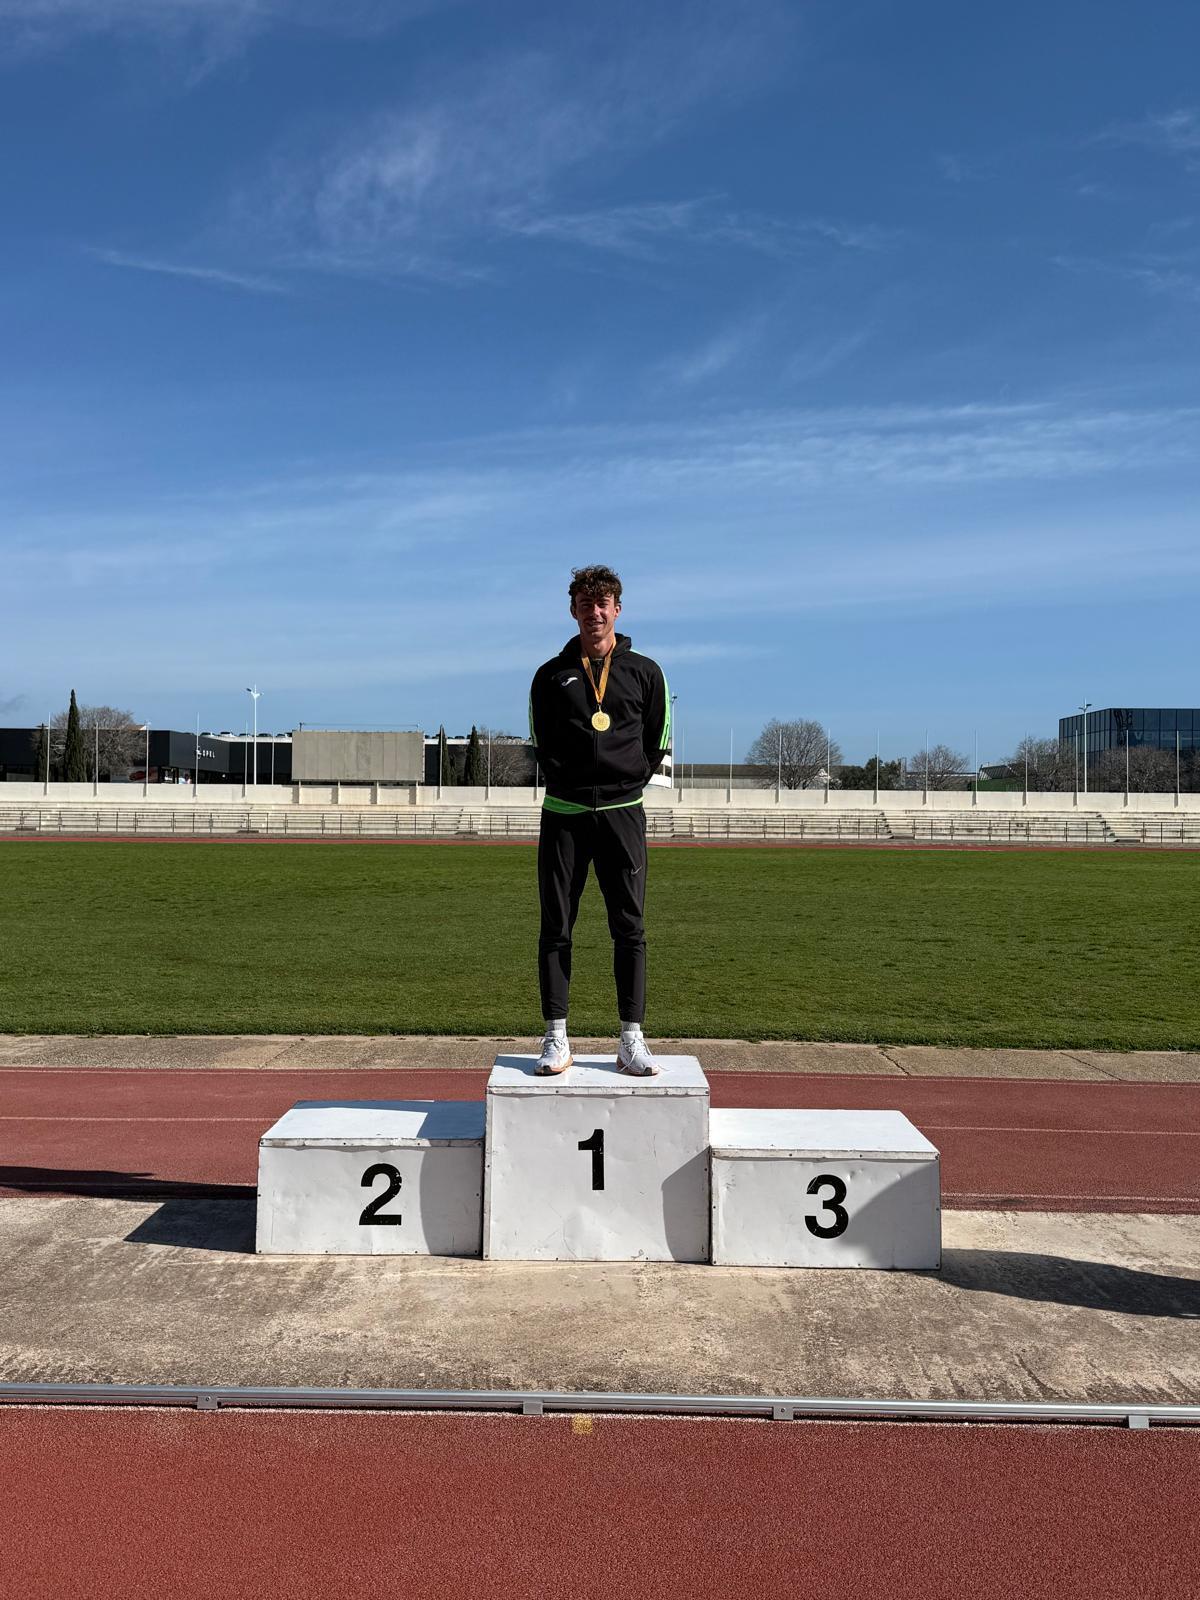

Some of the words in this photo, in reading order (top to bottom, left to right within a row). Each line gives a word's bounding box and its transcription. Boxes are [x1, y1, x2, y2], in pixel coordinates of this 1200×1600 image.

[202, 749, 216, 759] OPEL
[578, 1128, 605, 1191] 1
[358, 1163, 403, 1226] 2
[804, 1174, 849, 1239] 3
